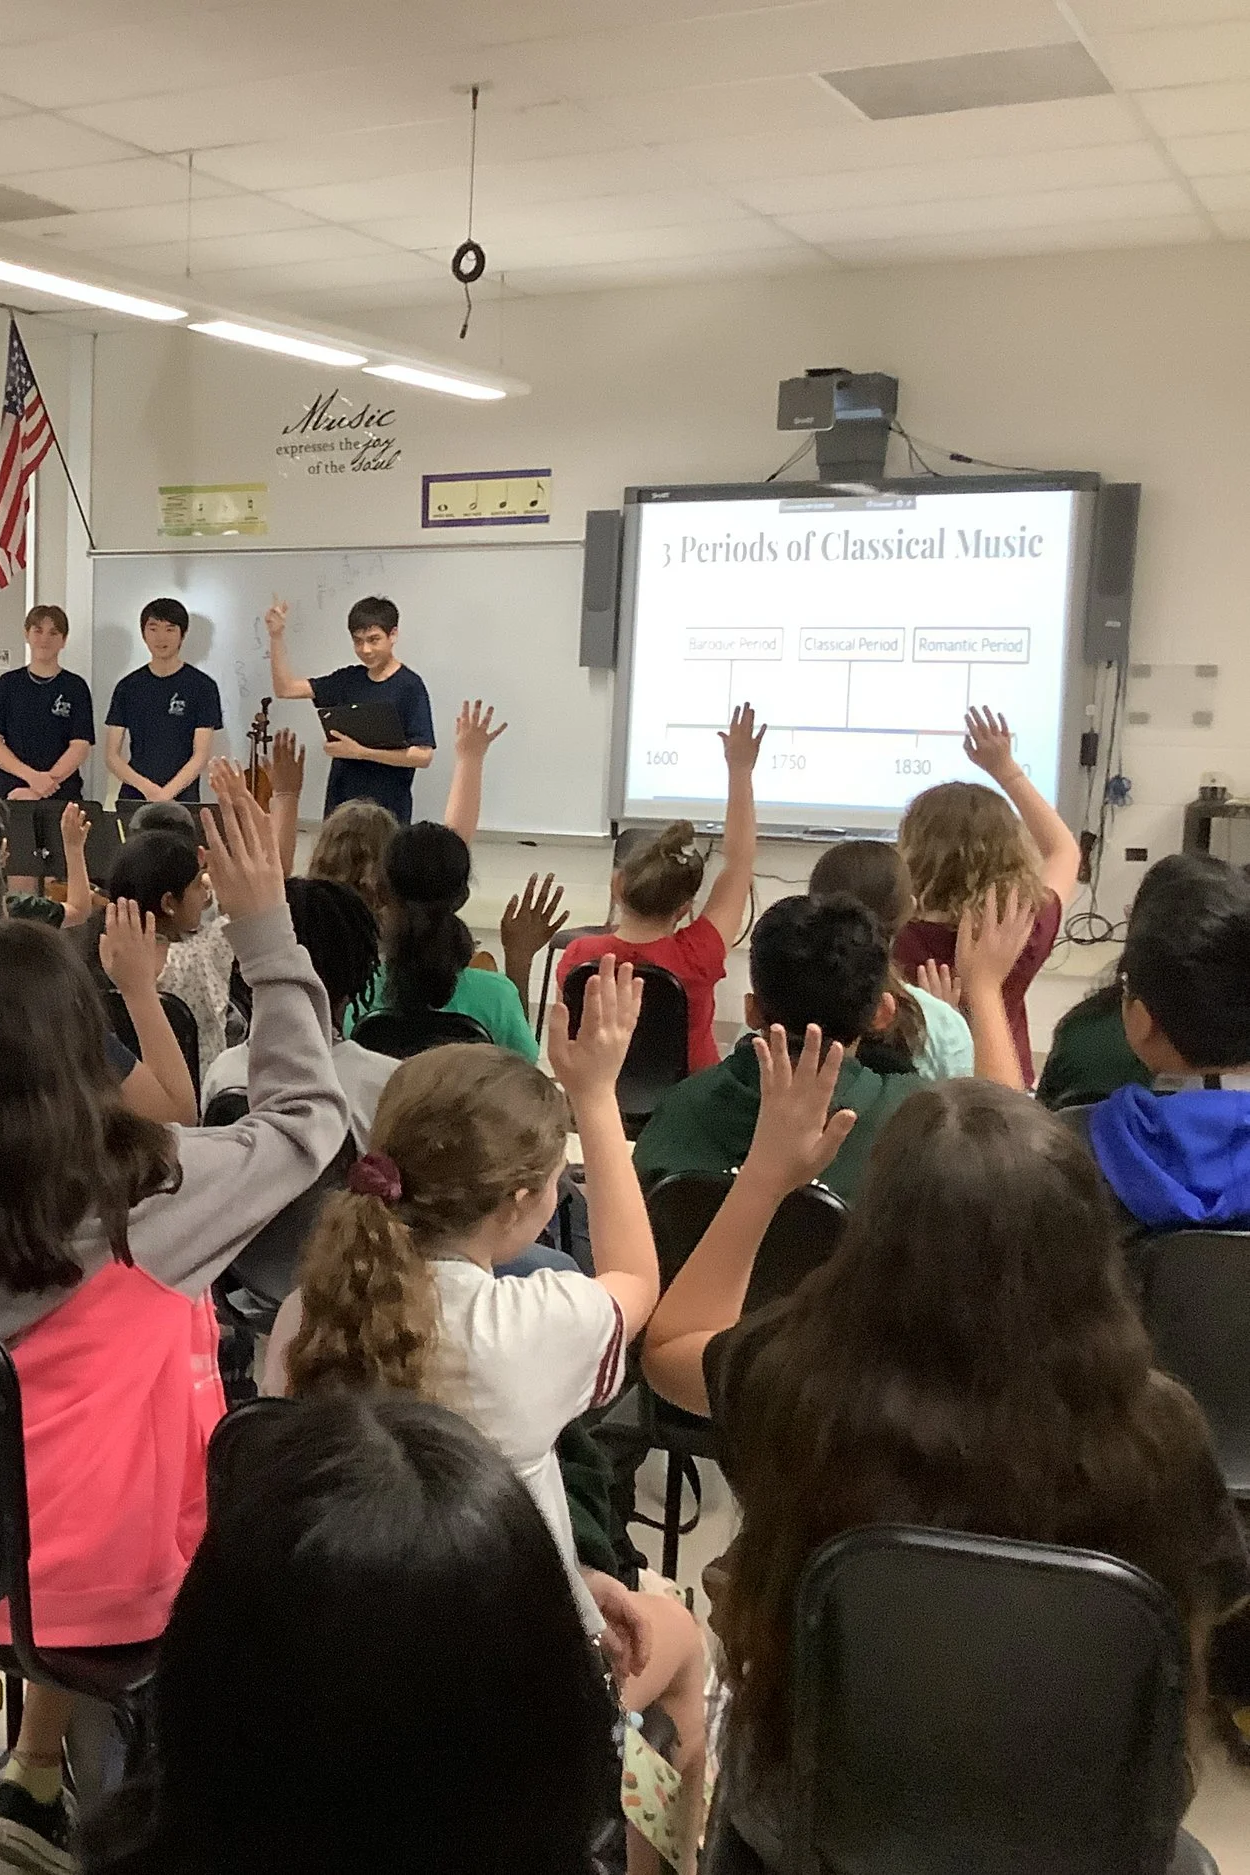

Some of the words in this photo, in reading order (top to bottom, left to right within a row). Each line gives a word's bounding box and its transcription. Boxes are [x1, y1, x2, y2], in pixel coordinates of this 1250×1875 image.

[281, 388, 397, 435] Music
[275, 442, 335, 458] expresses
[339, 437, 361, 450] the
[350, 437, 396, 465] joy
[307, 461, 324, 474] of
[325, 460, 346, 473] the
[351, 449, 402, 472] soul
[662, 543, 671, 568] 3
[681, 532, 778, 563] Periods
[787, 530, 817, 561] of
[821, 527, 945, 561] Classical
[954, 525, 1044, 559] Music
[739, 637, 777, 650] Period
[804, 637, 855, 651] Classical
[858, 637, 899, 651] Period
[918, 637, 978, 652] Romantic
[981, 637, 1023, 652] Period
[646, 750, 678, 765] 1600
[771, 754, 807, 769] 1750
[895, 759, 931, 775] 1830
